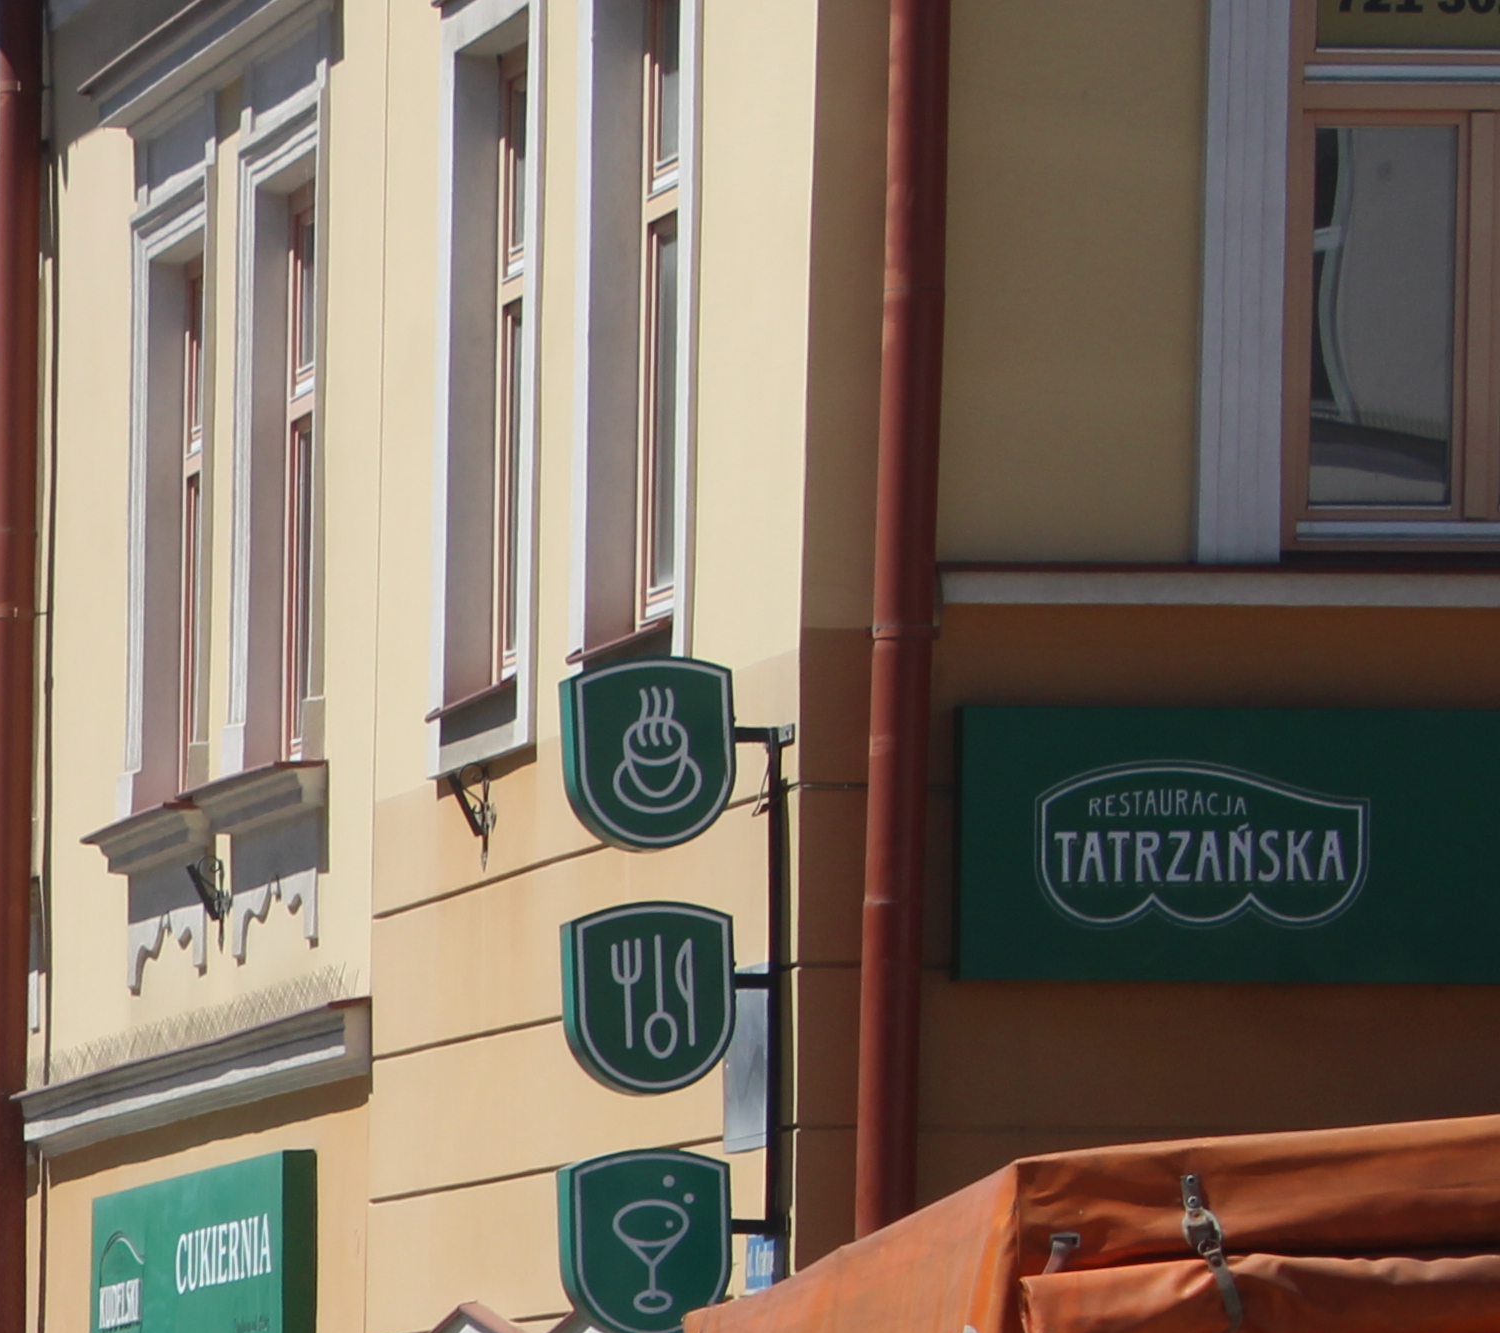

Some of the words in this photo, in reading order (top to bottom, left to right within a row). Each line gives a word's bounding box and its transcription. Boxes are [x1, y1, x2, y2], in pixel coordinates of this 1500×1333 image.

[1088, 788, 1248, 817] RESTAURACJA
[1054, 822, 1348, 883] TATRZAŃSKA
[175, 1213, 272, 1295] CUKIERNIA
